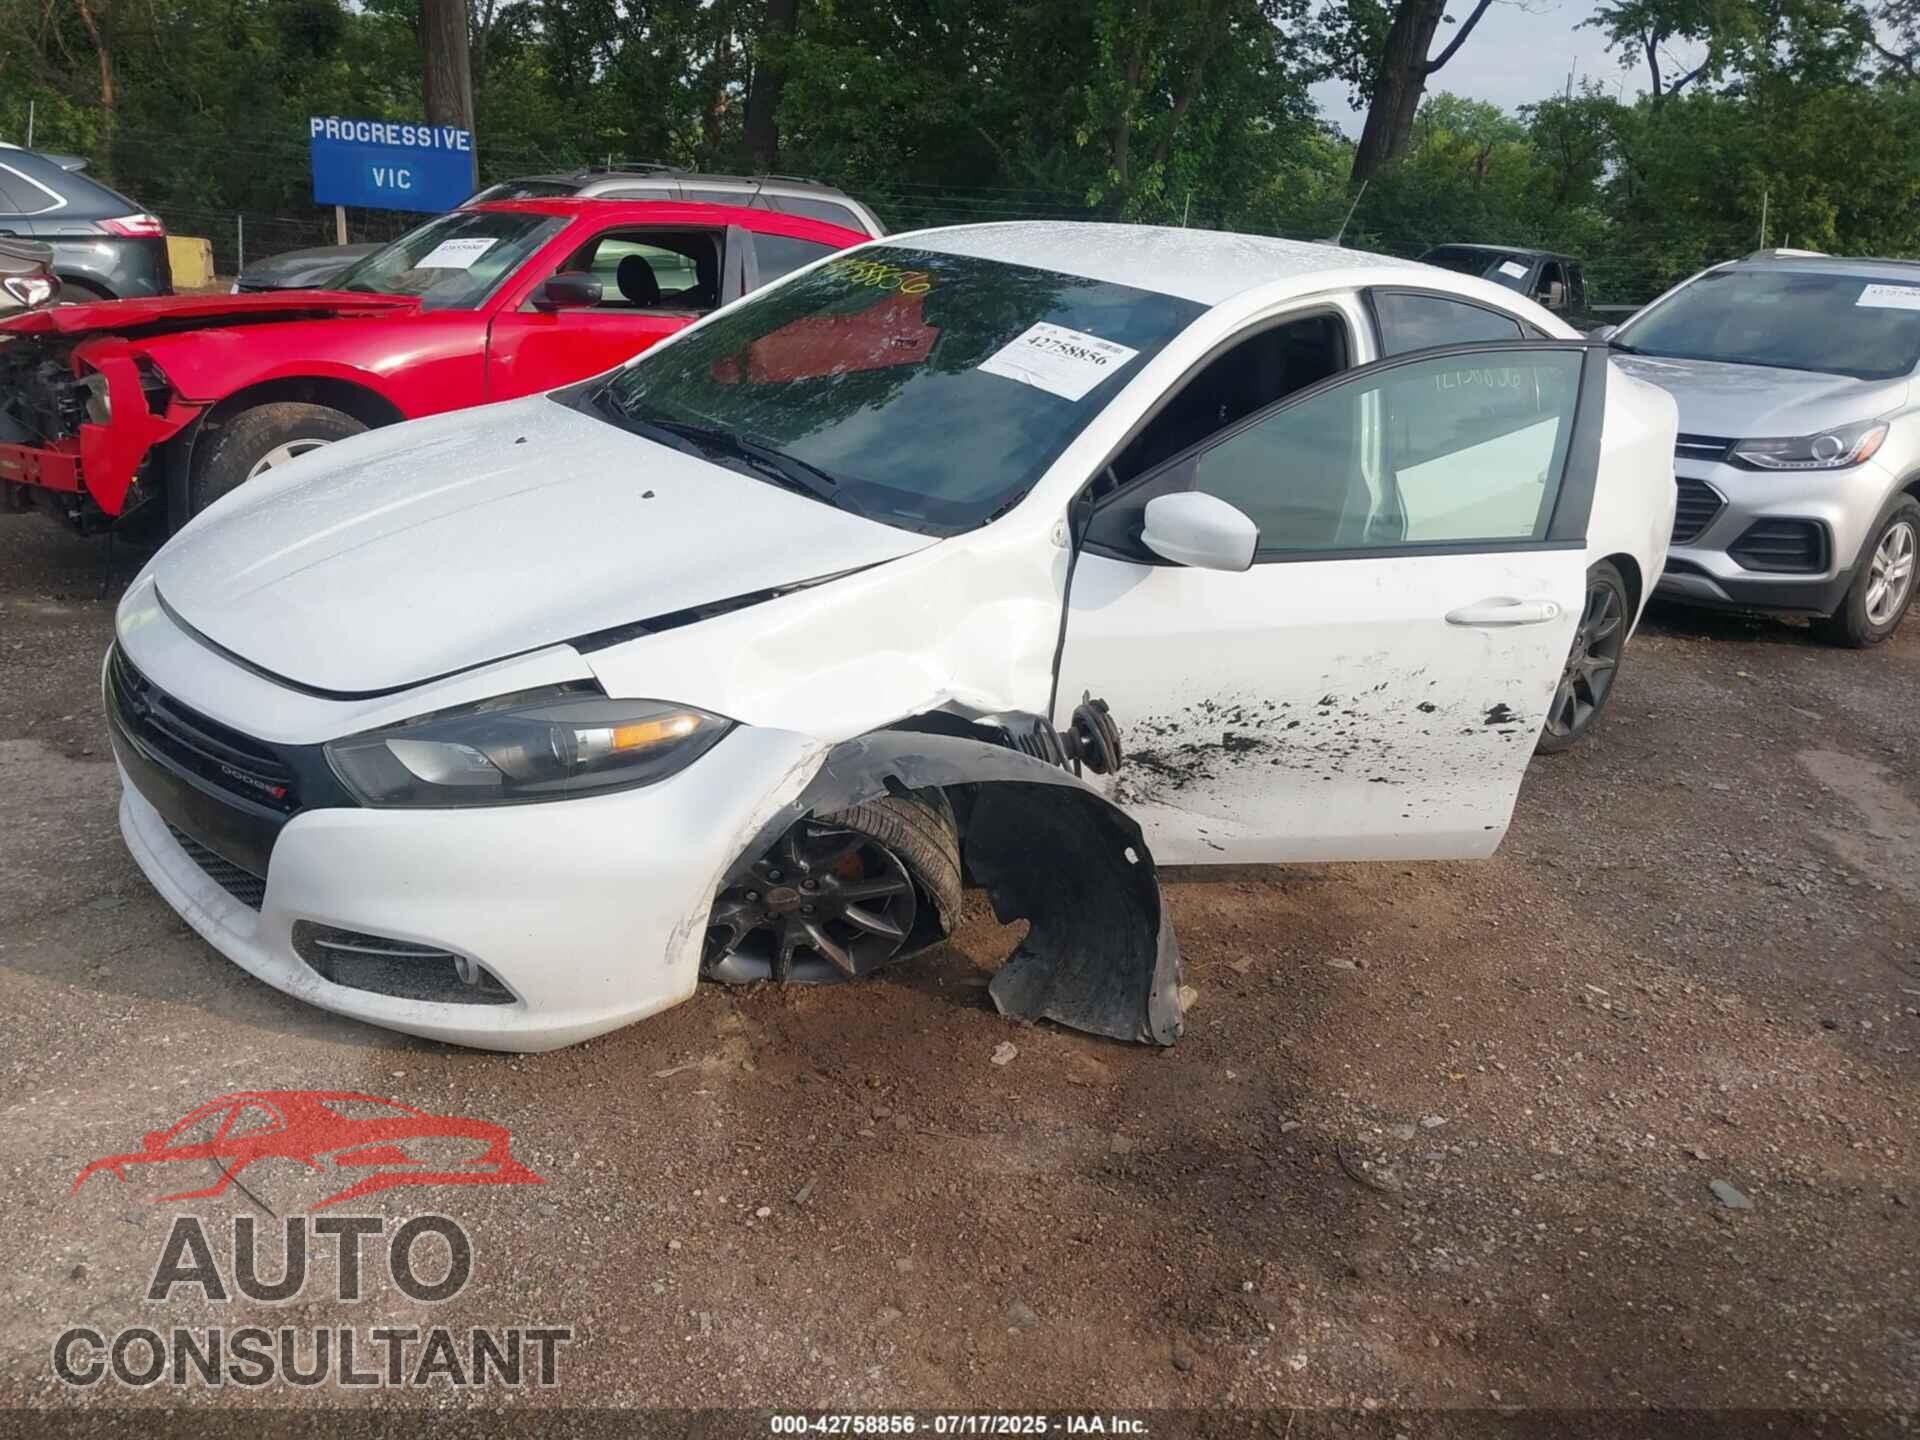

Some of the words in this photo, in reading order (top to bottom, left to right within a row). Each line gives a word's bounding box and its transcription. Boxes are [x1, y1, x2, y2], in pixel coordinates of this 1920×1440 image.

[310, 117, 471, 151] PROGRESSIVE
[372, 167, 412, 189] VIC
[1027, 335, 1108, 366] 42758856
